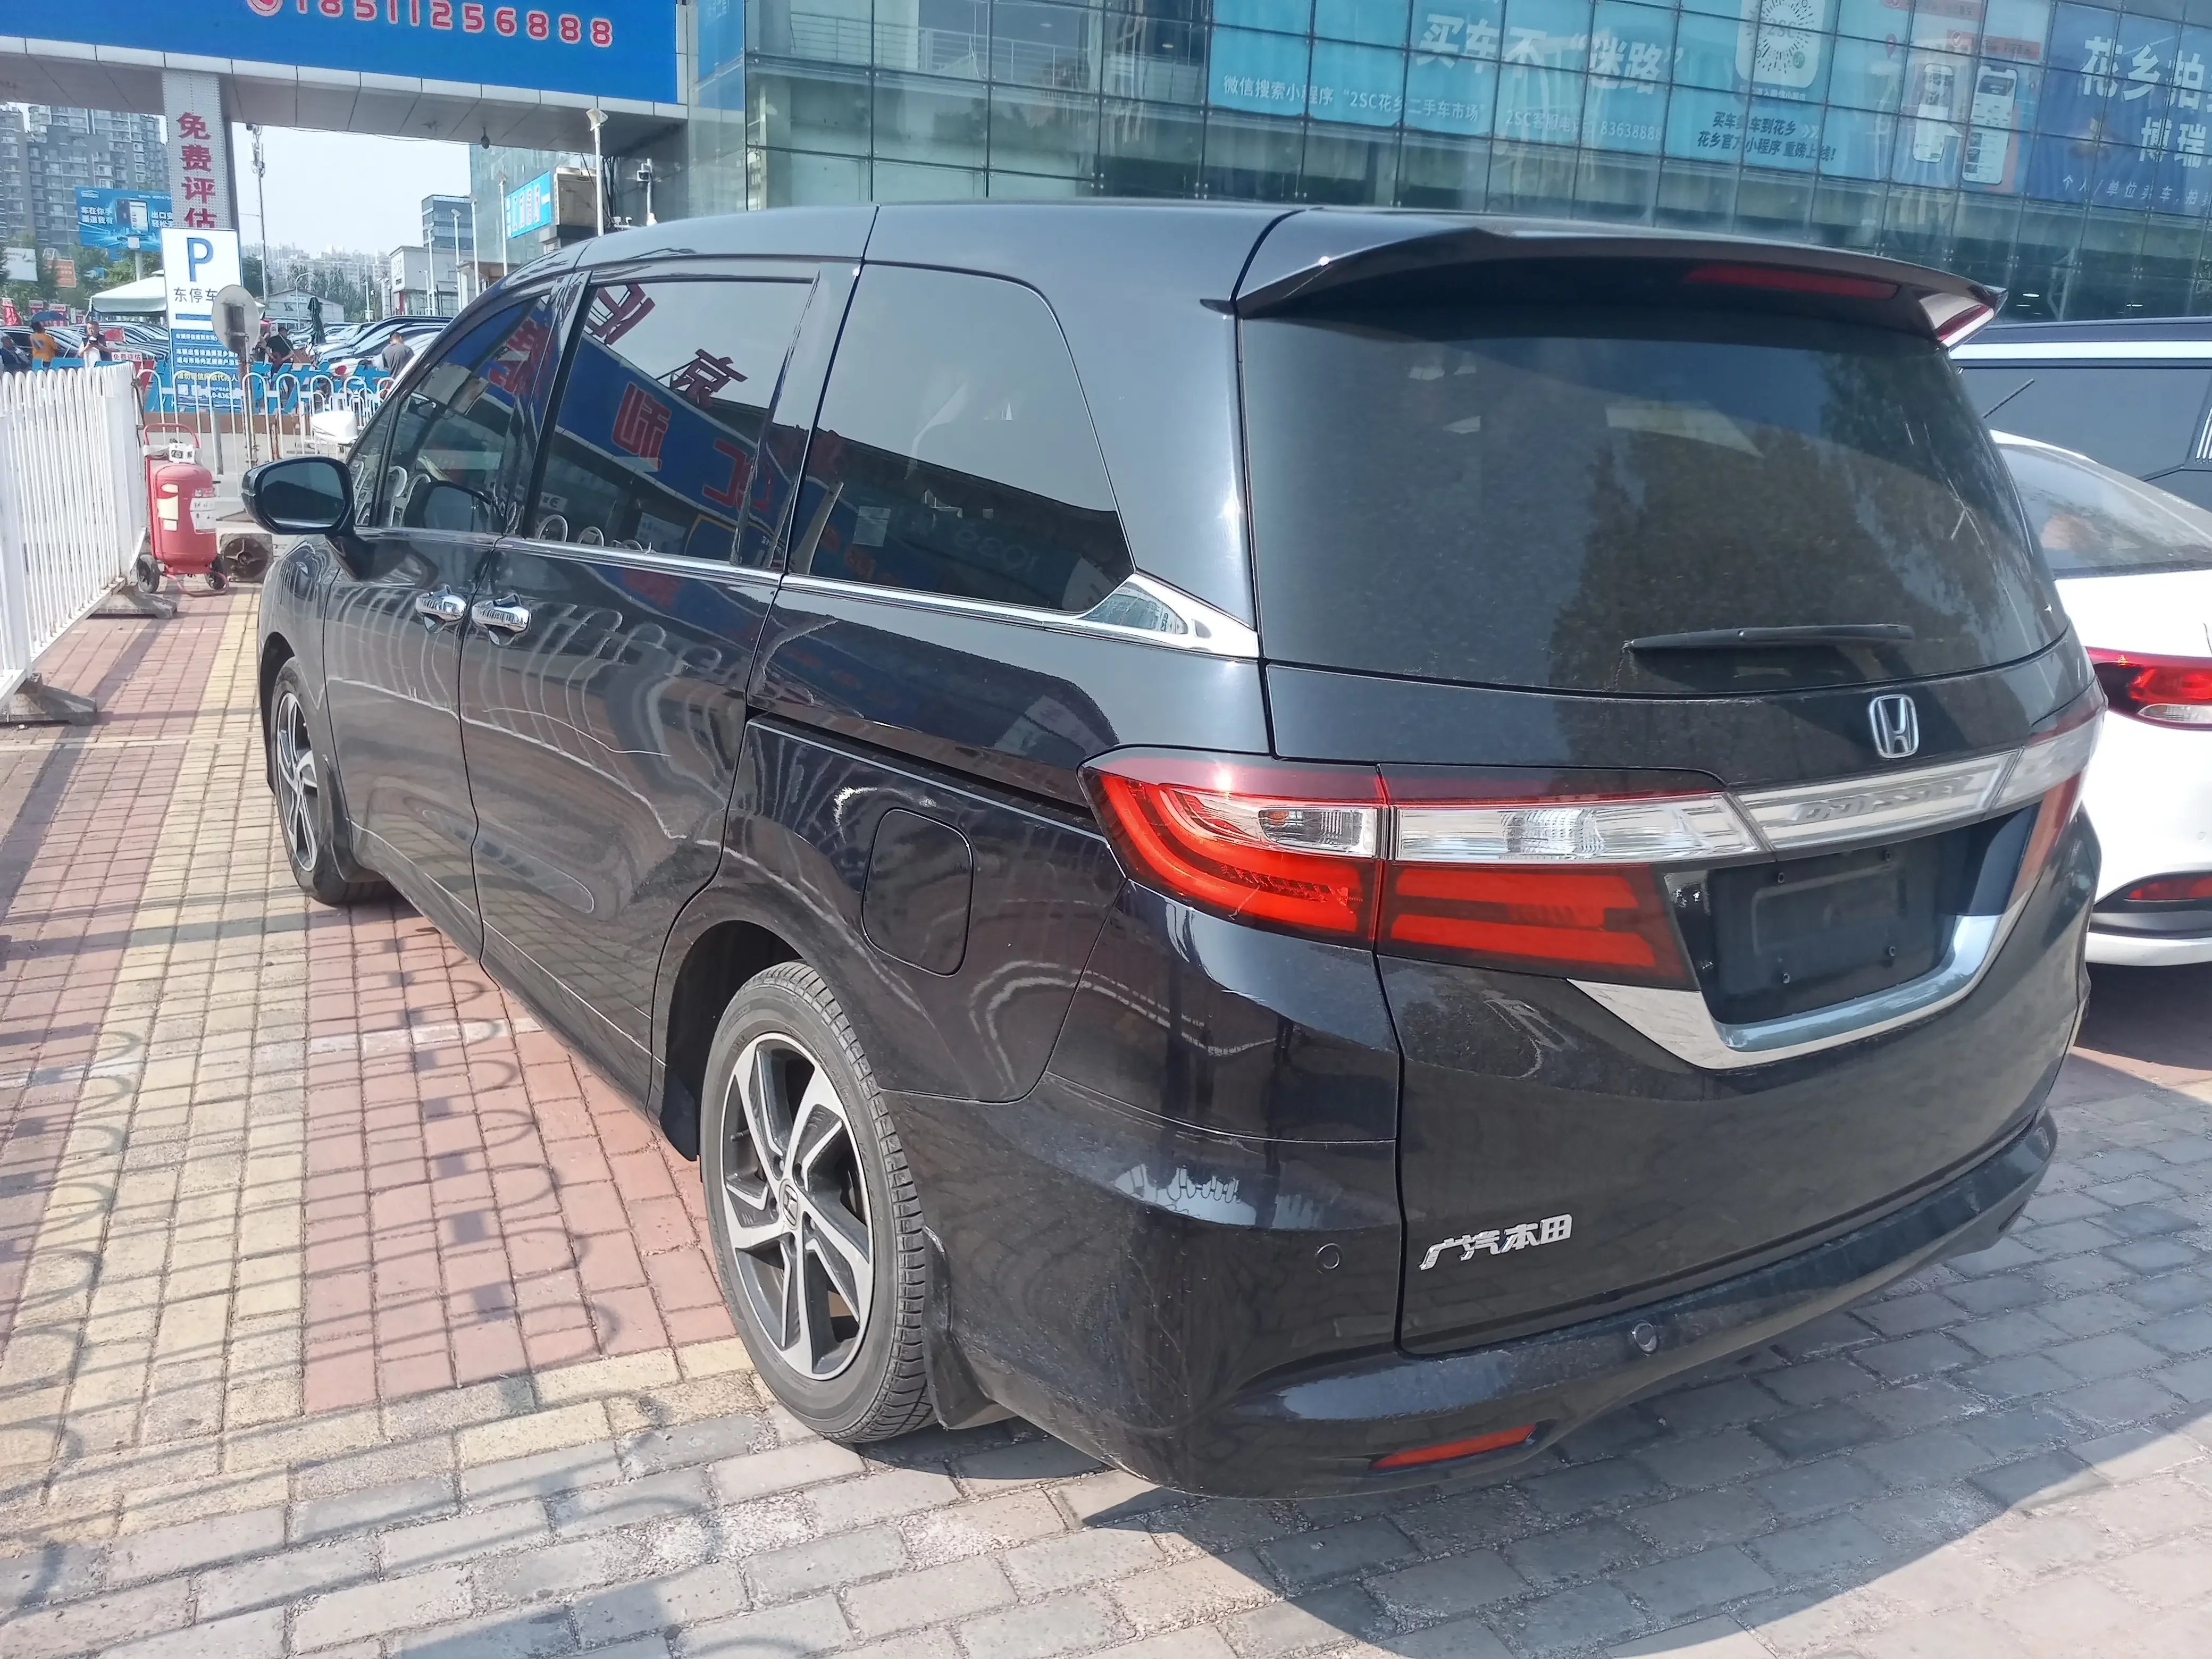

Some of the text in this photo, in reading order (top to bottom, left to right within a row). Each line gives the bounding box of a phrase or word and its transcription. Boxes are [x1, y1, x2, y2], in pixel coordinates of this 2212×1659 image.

[1224, 74, 1334, 106] 微信搜索小程序
[2079, 36, 2212, 113] 花乡拍
[2139, 116, 2212, 169] 博瑞
[177, 112, 217, 229] 免费评估
[187, 237, 214, 282] P
[1419, 1213, 1572, 1271] 广汽本田
